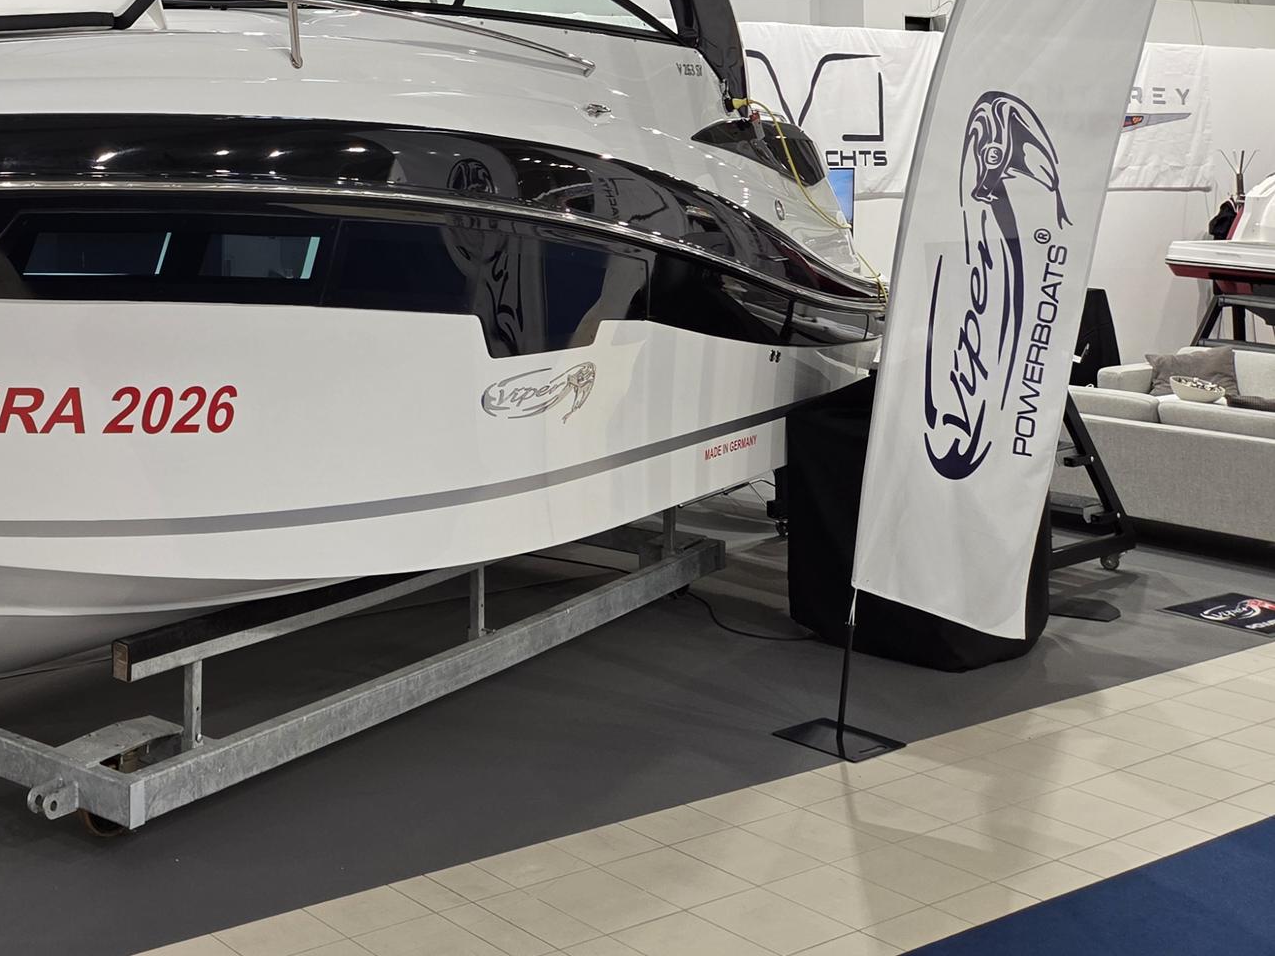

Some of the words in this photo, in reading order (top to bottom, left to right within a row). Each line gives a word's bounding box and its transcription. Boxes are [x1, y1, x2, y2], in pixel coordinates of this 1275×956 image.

[825, 150, 888, 167] CHTS
[102, 384, 239, 435] 2026
[704, 445, 722, 461] MADE
[722, 443, 729, 455] IN
[729, 434, 758, 452] GERMANY
